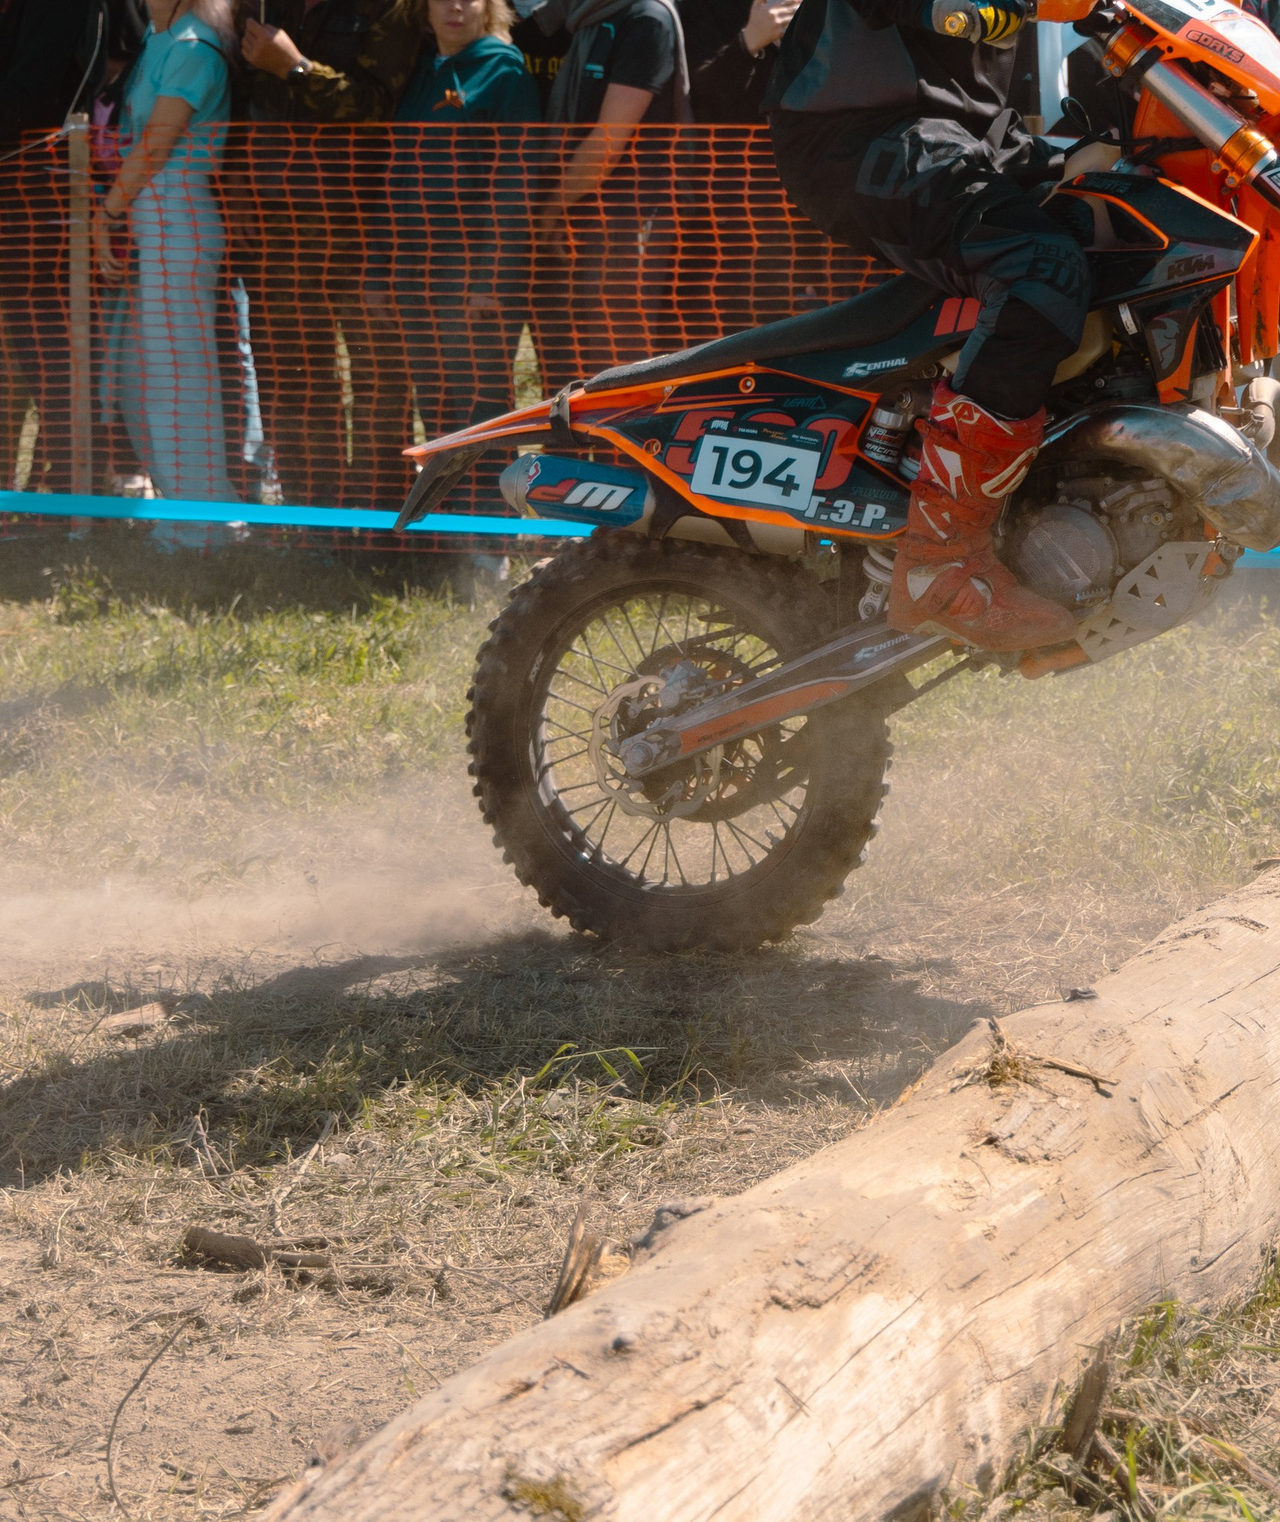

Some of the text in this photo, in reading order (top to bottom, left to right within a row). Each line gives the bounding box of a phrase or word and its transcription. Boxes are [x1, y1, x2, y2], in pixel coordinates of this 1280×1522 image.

[1185, 29, 1245, 64] 6DAYS
[1167, 253, 1216, 281] KTM
[843, 358, 908, 377] RENTHAL
[711, 445, 801, 498] 194
